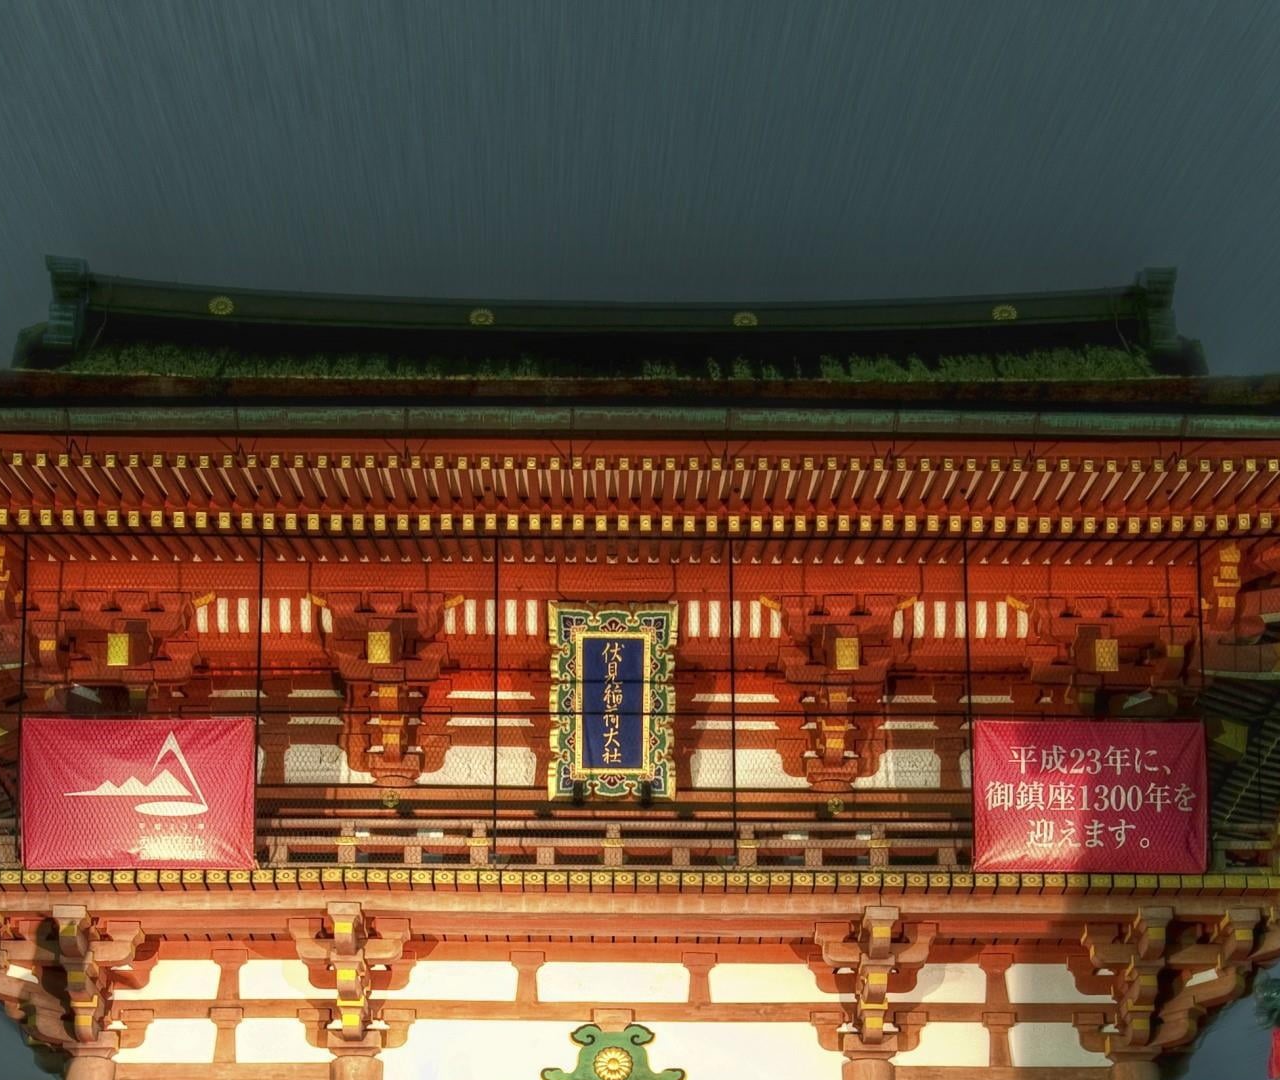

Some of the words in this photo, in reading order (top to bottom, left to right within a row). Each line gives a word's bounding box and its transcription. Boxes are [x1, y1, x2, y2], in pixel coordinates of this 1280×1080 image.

[1008, 744, 1172, 776] 平成23年に、
[984, 781, 1197, 813] 御鎮座1300年を
[1026, 818, 1150, 850] 迎えます。
